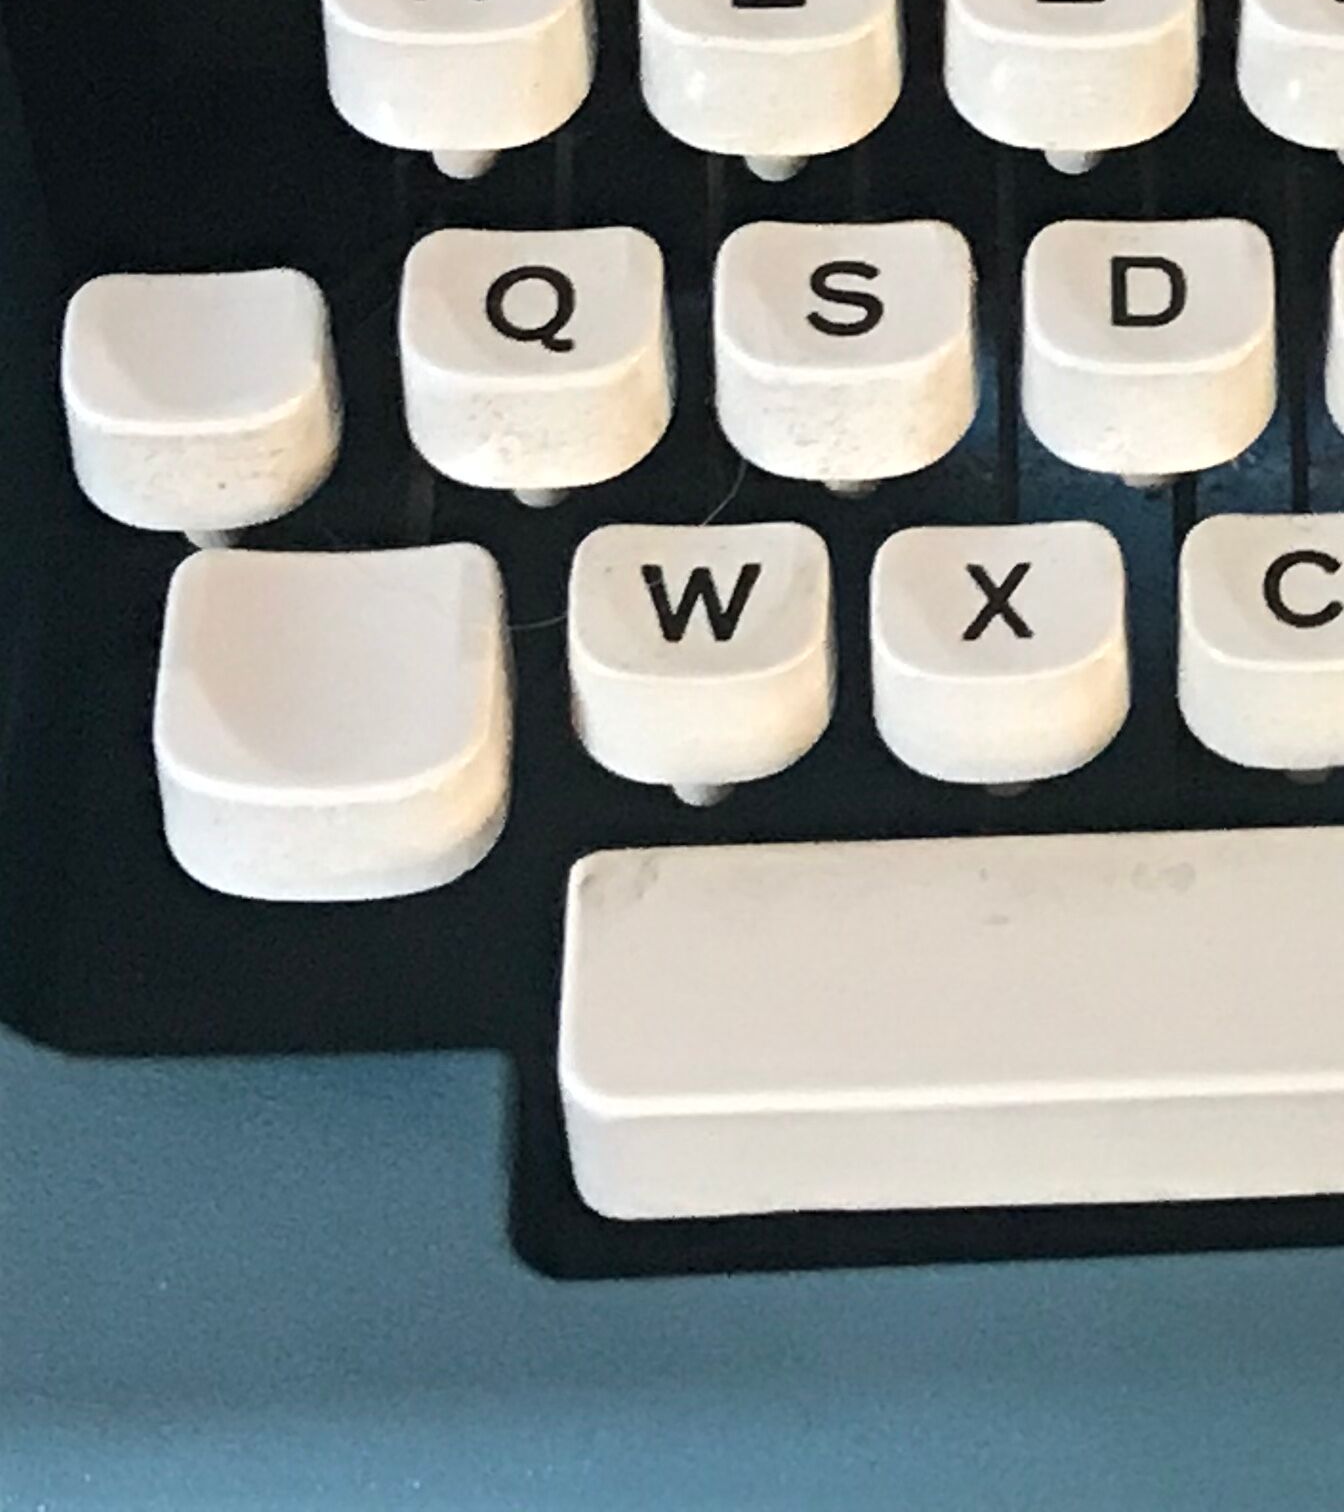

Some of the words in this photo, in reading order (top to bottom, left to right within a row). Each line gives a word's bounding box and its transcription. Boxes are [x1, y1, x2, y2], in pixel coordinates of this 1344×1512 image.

[484, 264, 576, 346] Q
[805, 259, 885, 338] S
[1109, 255, 1188, 328] D
[640, 562, 762, 644] W
[961, 561, 1034, 642] X
[1262, 548, 1344, 630] C
